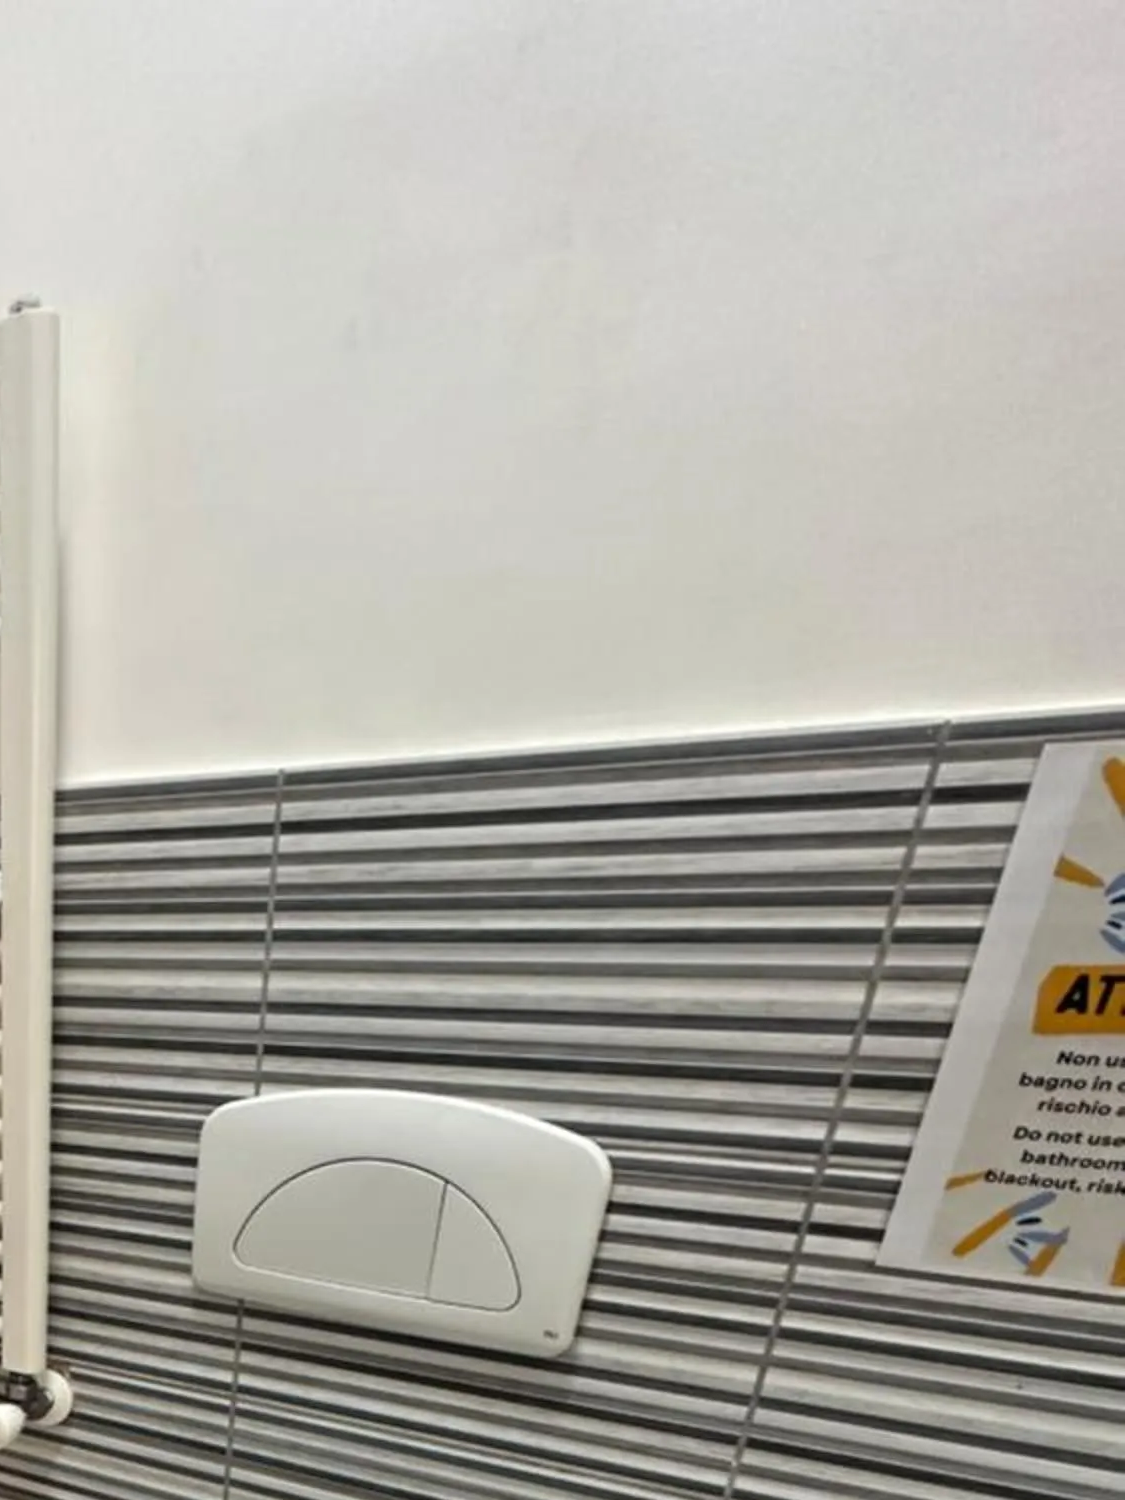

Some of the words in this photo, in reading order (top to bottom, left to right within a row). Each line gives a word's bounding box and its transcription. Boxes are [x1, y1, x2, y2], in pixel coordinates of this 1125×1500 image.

[1054, 973, 1125, 1017] AT
[1056, 1050, 1101, 1067] Non
[1018, 1071, 1087, 1093] bagno
[1091, 1075, 1113, 1092] in
[1037, 1097, 1112, 1117] rischio
[1012, 1125, 1043, 1142] Do
[1046, 1130, 1083, 1145] not
[983, 1169, 1082, 1193] blackout,
